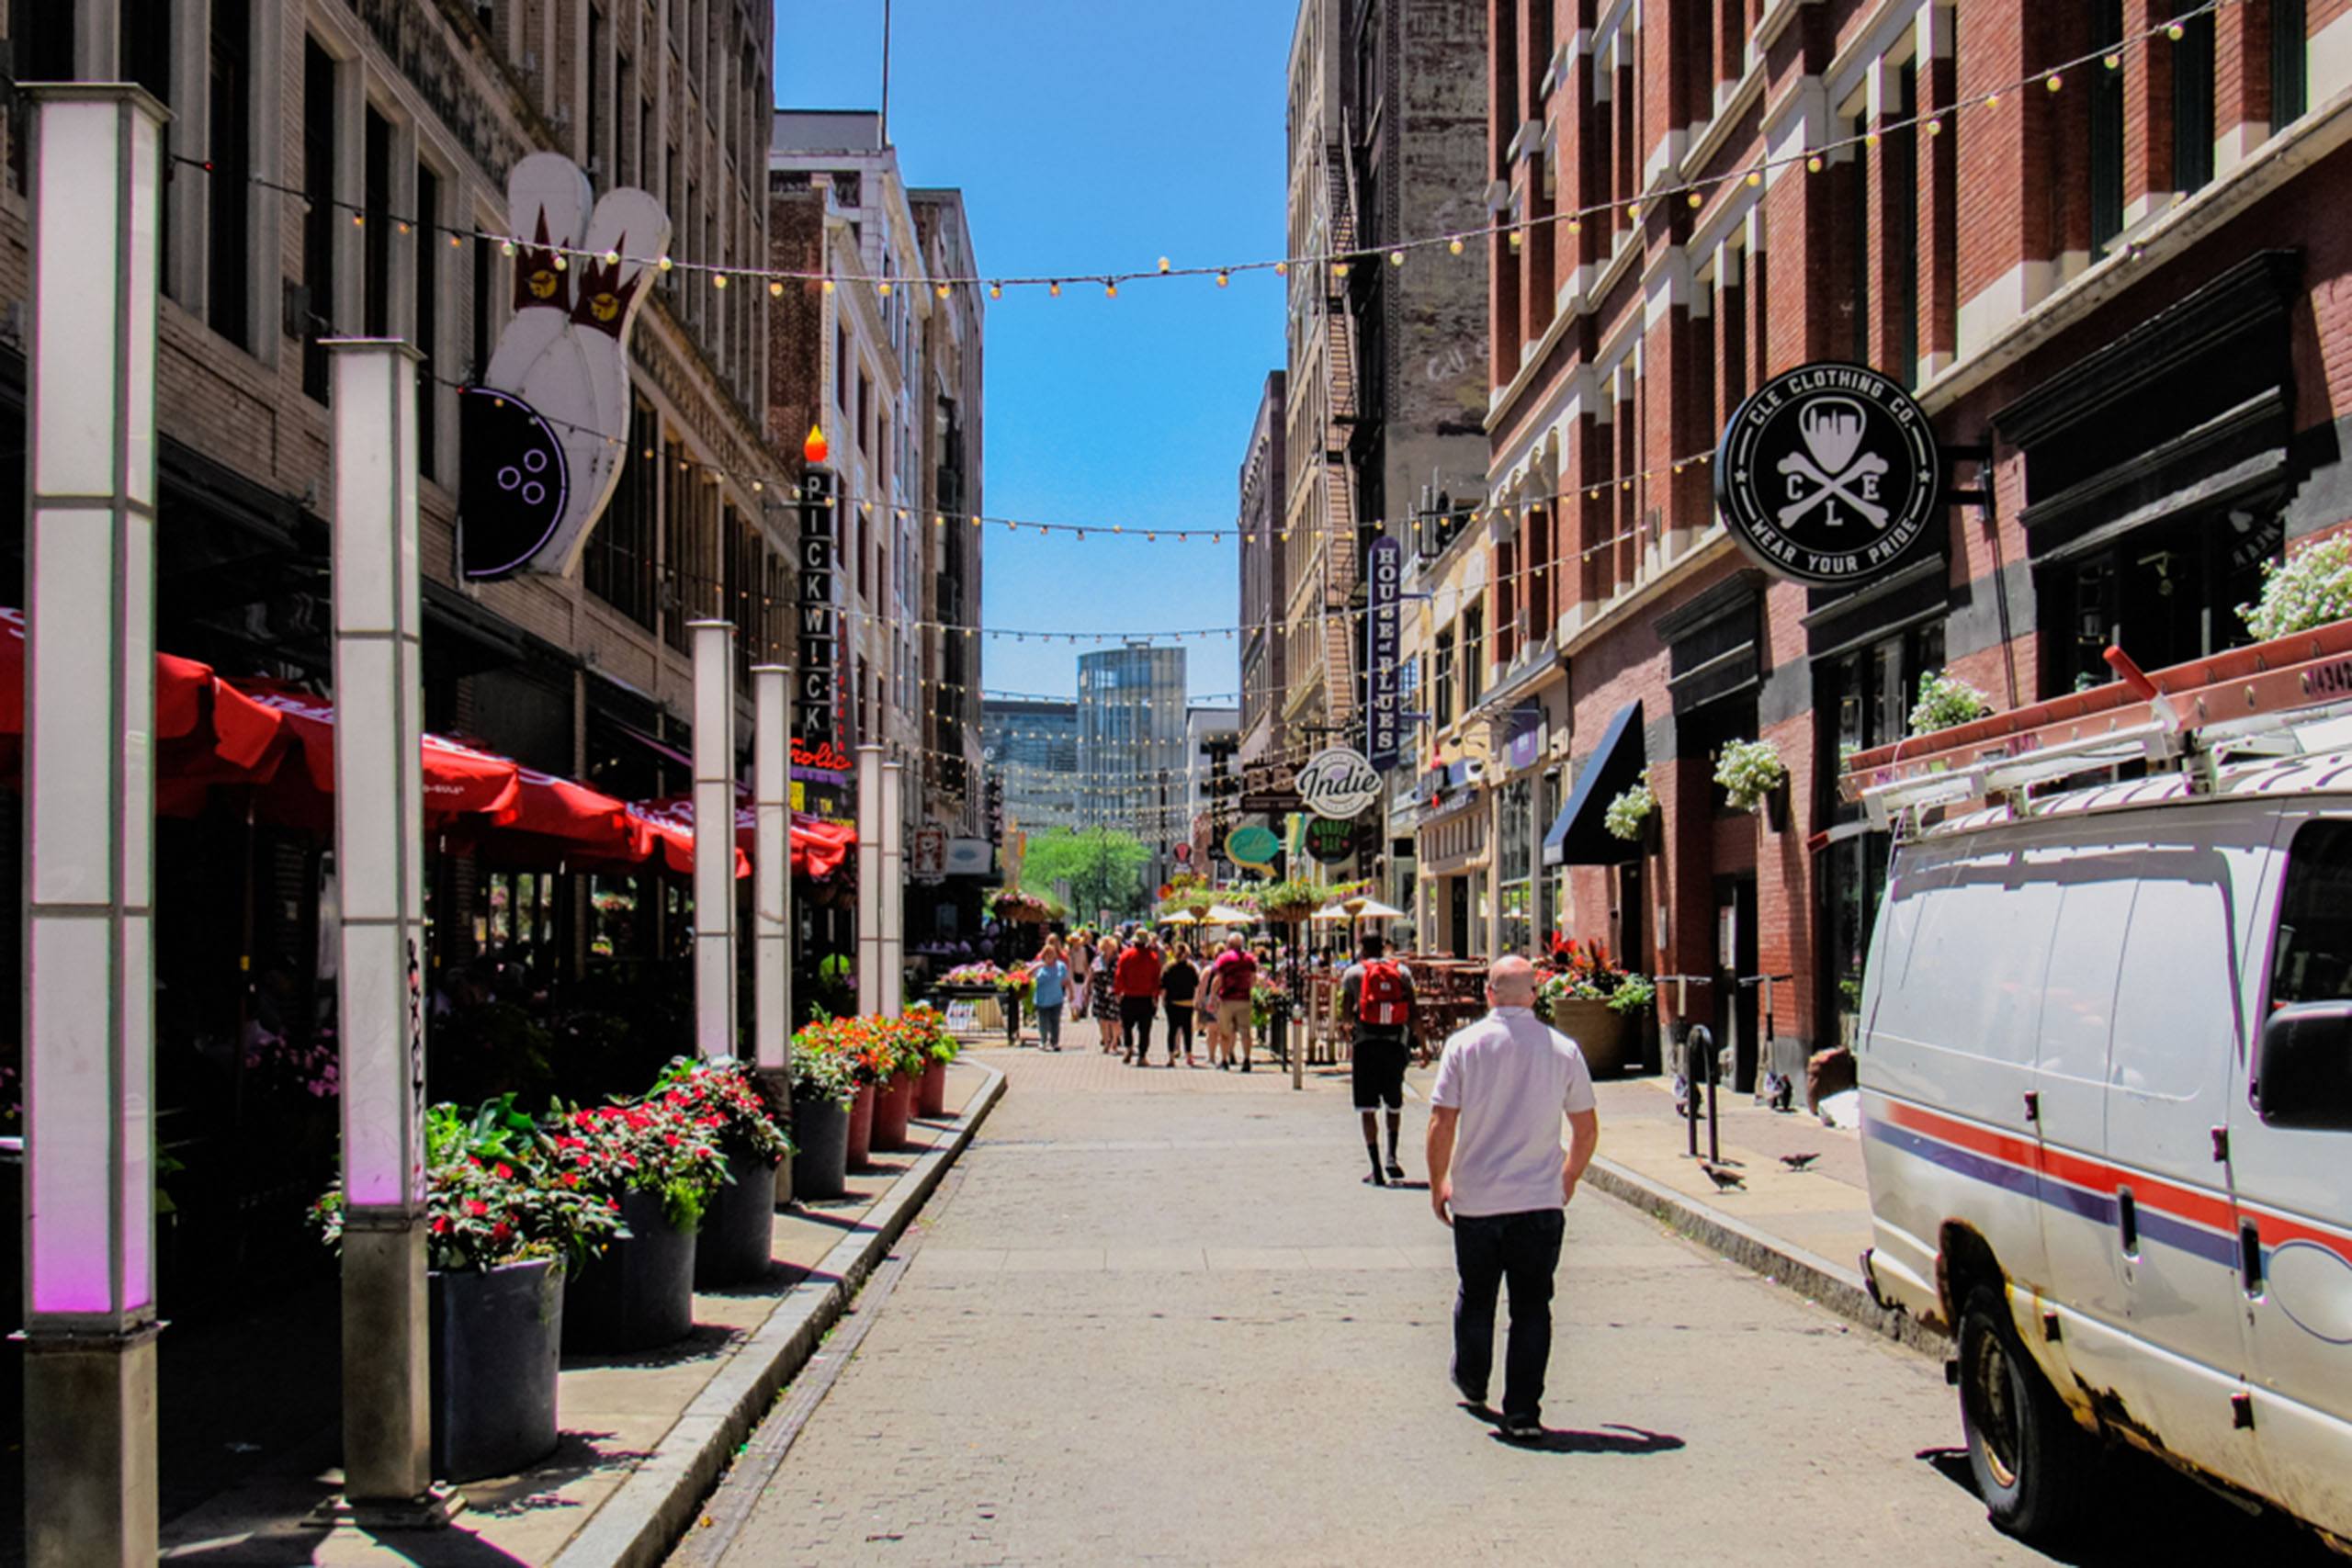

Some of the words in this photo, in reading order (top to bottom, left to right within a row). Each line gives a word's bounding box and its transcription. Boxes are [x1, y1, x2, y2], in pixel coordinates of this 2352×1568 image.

[1748, 390, 1783, 426] CLE
[1788, 369, 1884, 399] CLOTHING
[1751, 518, 1798, 564] WEAR
[1807, 554, 1859, 573] YOUR
[1869, 517, 1918, 565] PRIDE
[805, 475, 824, 730] PICKWICK
[1378, 547, 1396, 639] HOUSE
[1377, 657, 1395, 750] BLUES
[1299, 764, 1381, 801] Indie
